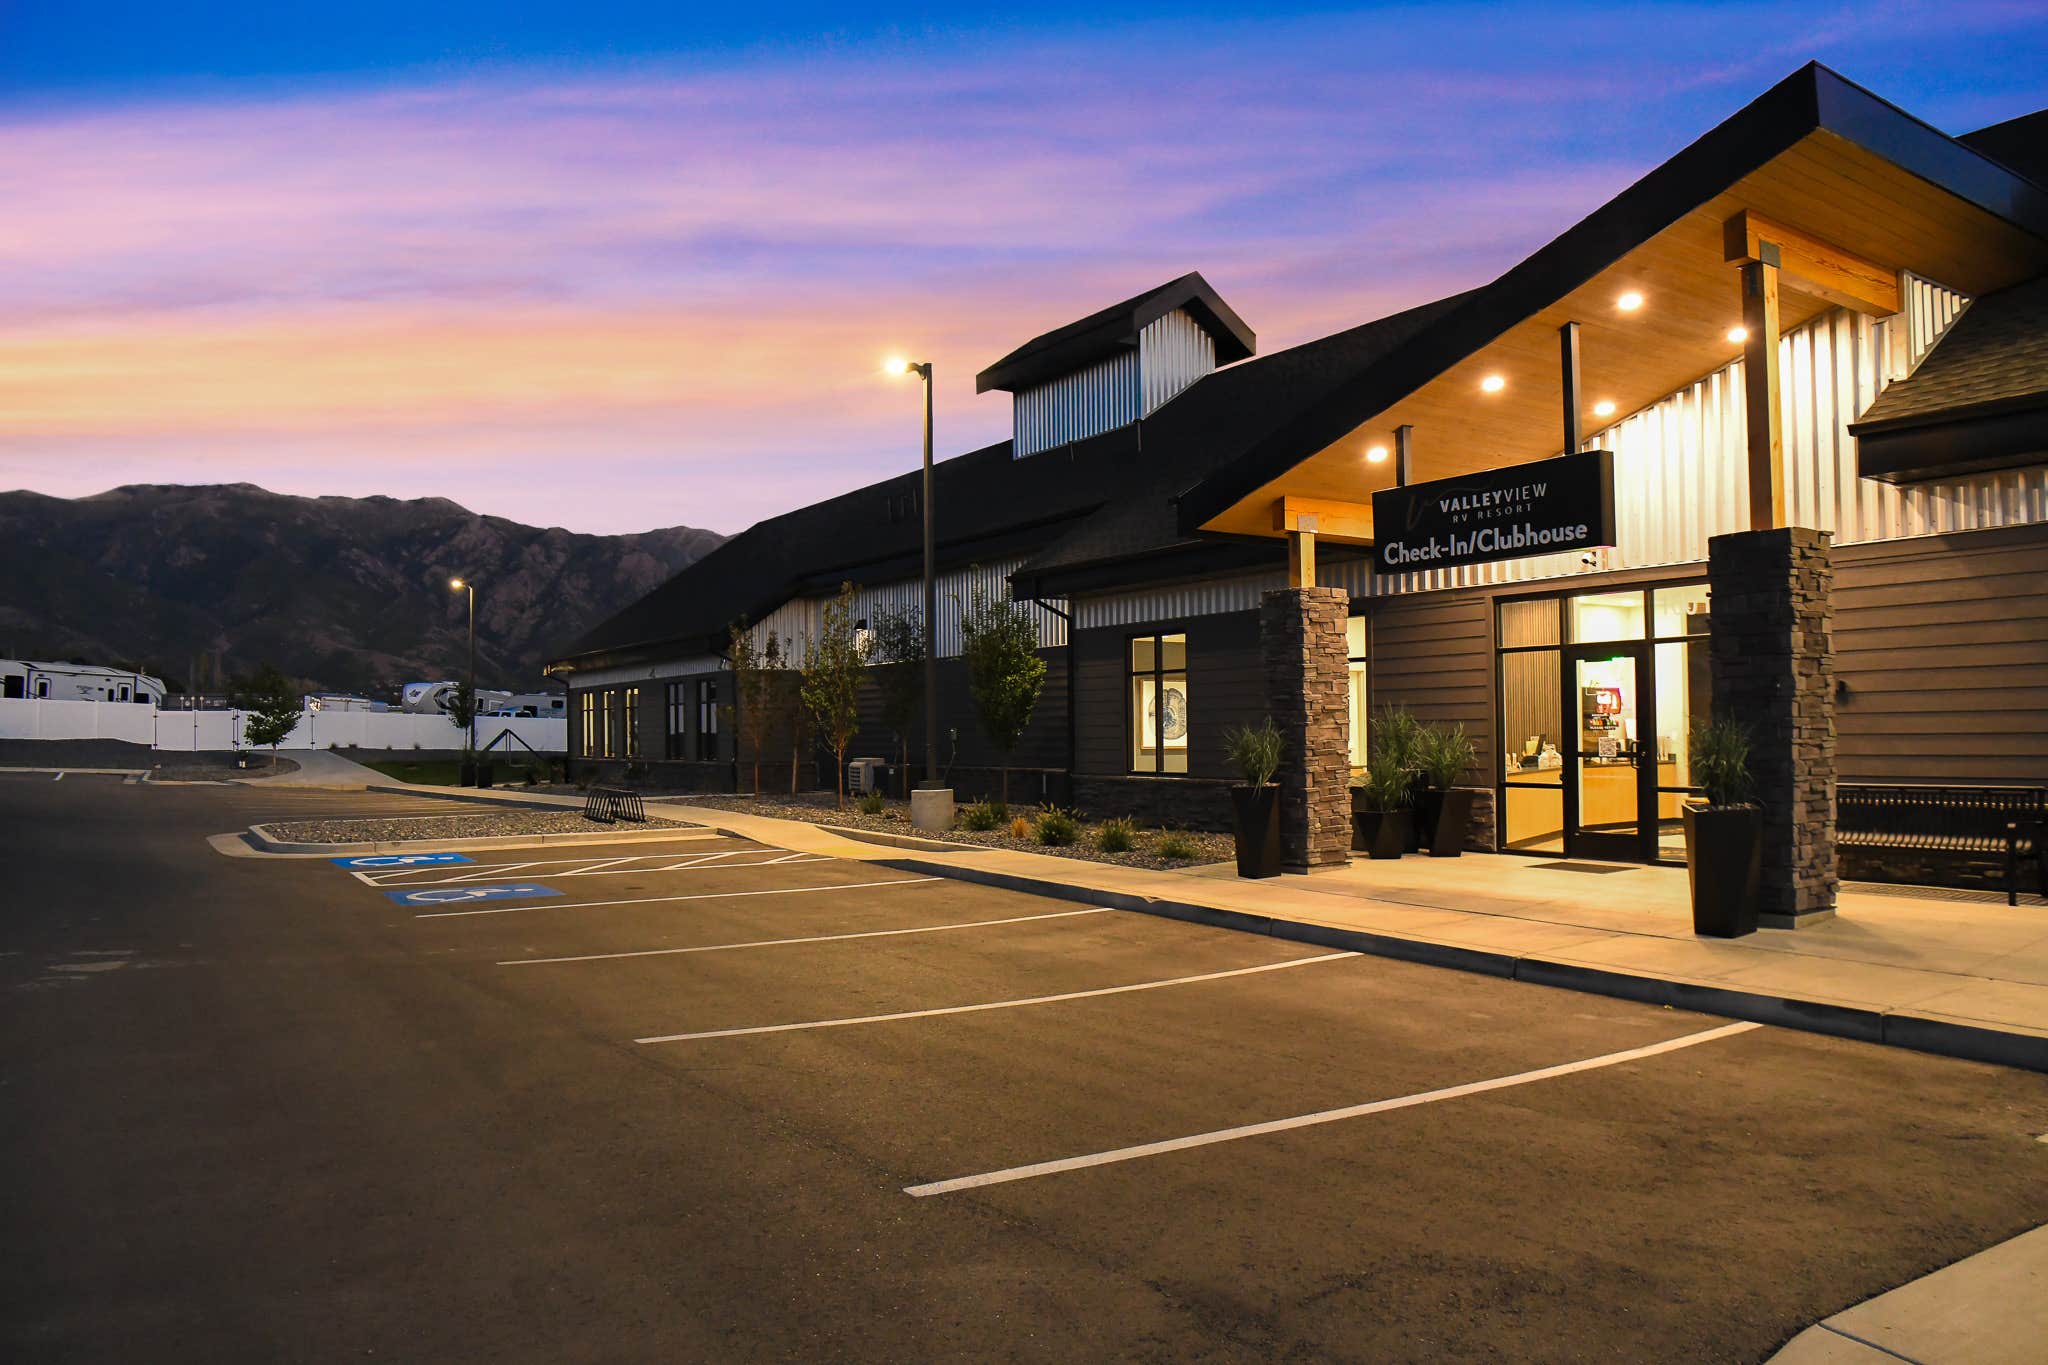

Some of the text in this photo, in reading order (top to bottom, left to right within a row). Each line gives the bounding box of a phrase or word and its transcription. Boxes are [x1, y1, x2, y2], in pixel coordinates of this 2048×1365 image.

[1440, 483, 1547, 513] VALLEYVIEW
[1452, 503, 1532, 523] RV RESORT
[1384, 523, 1588, 565] Check-In/Clubhouse
